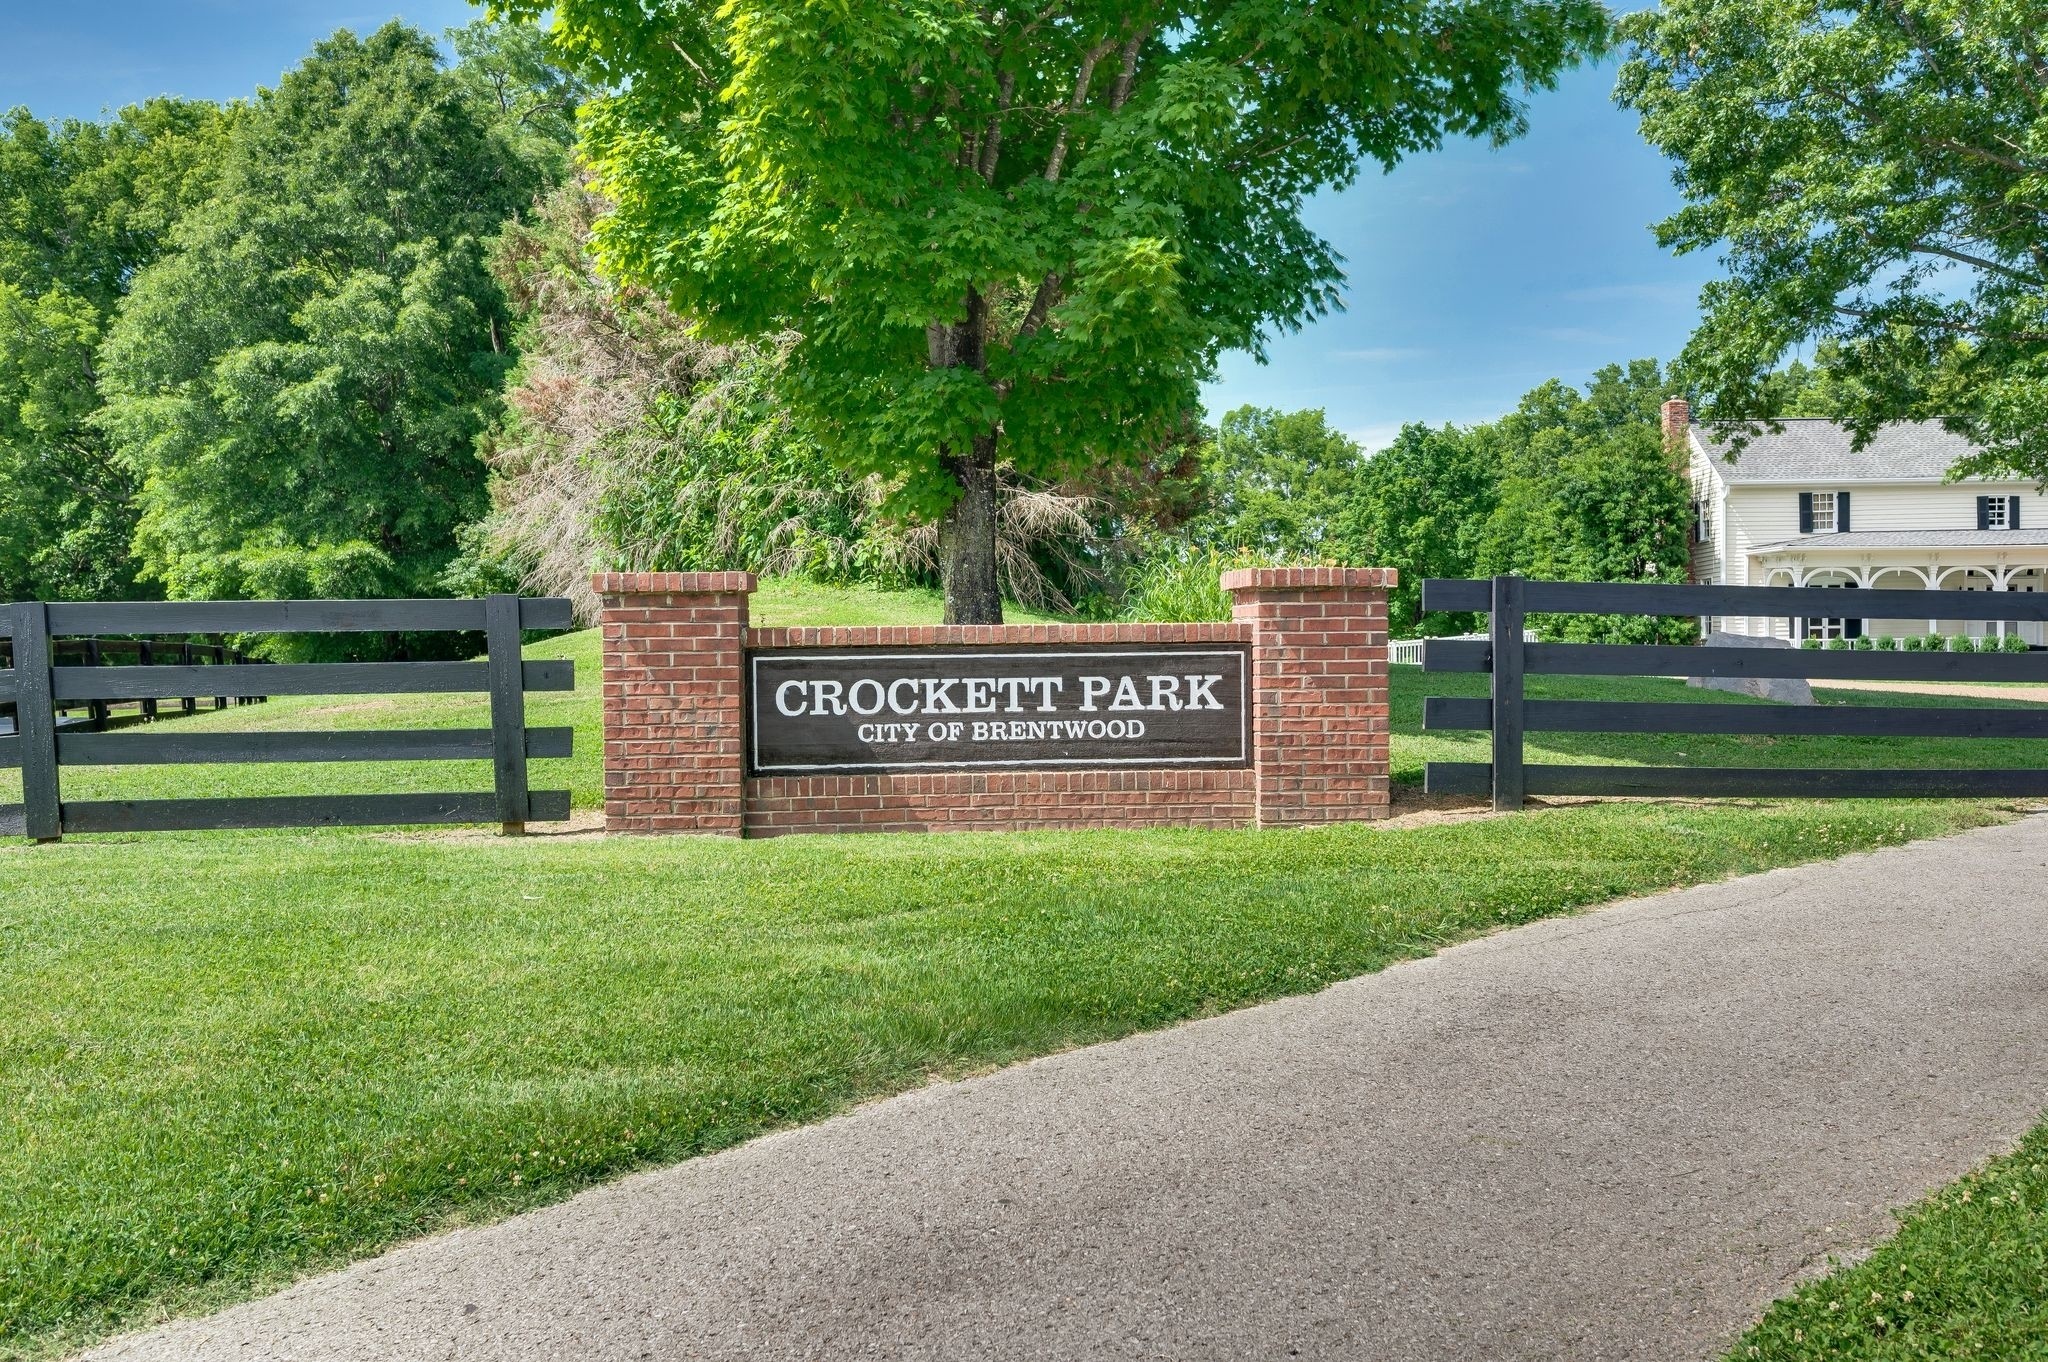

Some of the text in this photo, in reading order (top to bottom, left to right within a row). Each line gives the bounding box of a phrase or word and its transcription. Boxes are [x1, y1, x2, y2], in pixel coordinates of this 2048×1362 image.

[774, 674, 1225, 717] CROCKETT PARK
[857, 719, 1146, 743] CITY OF BRENTWOOD
